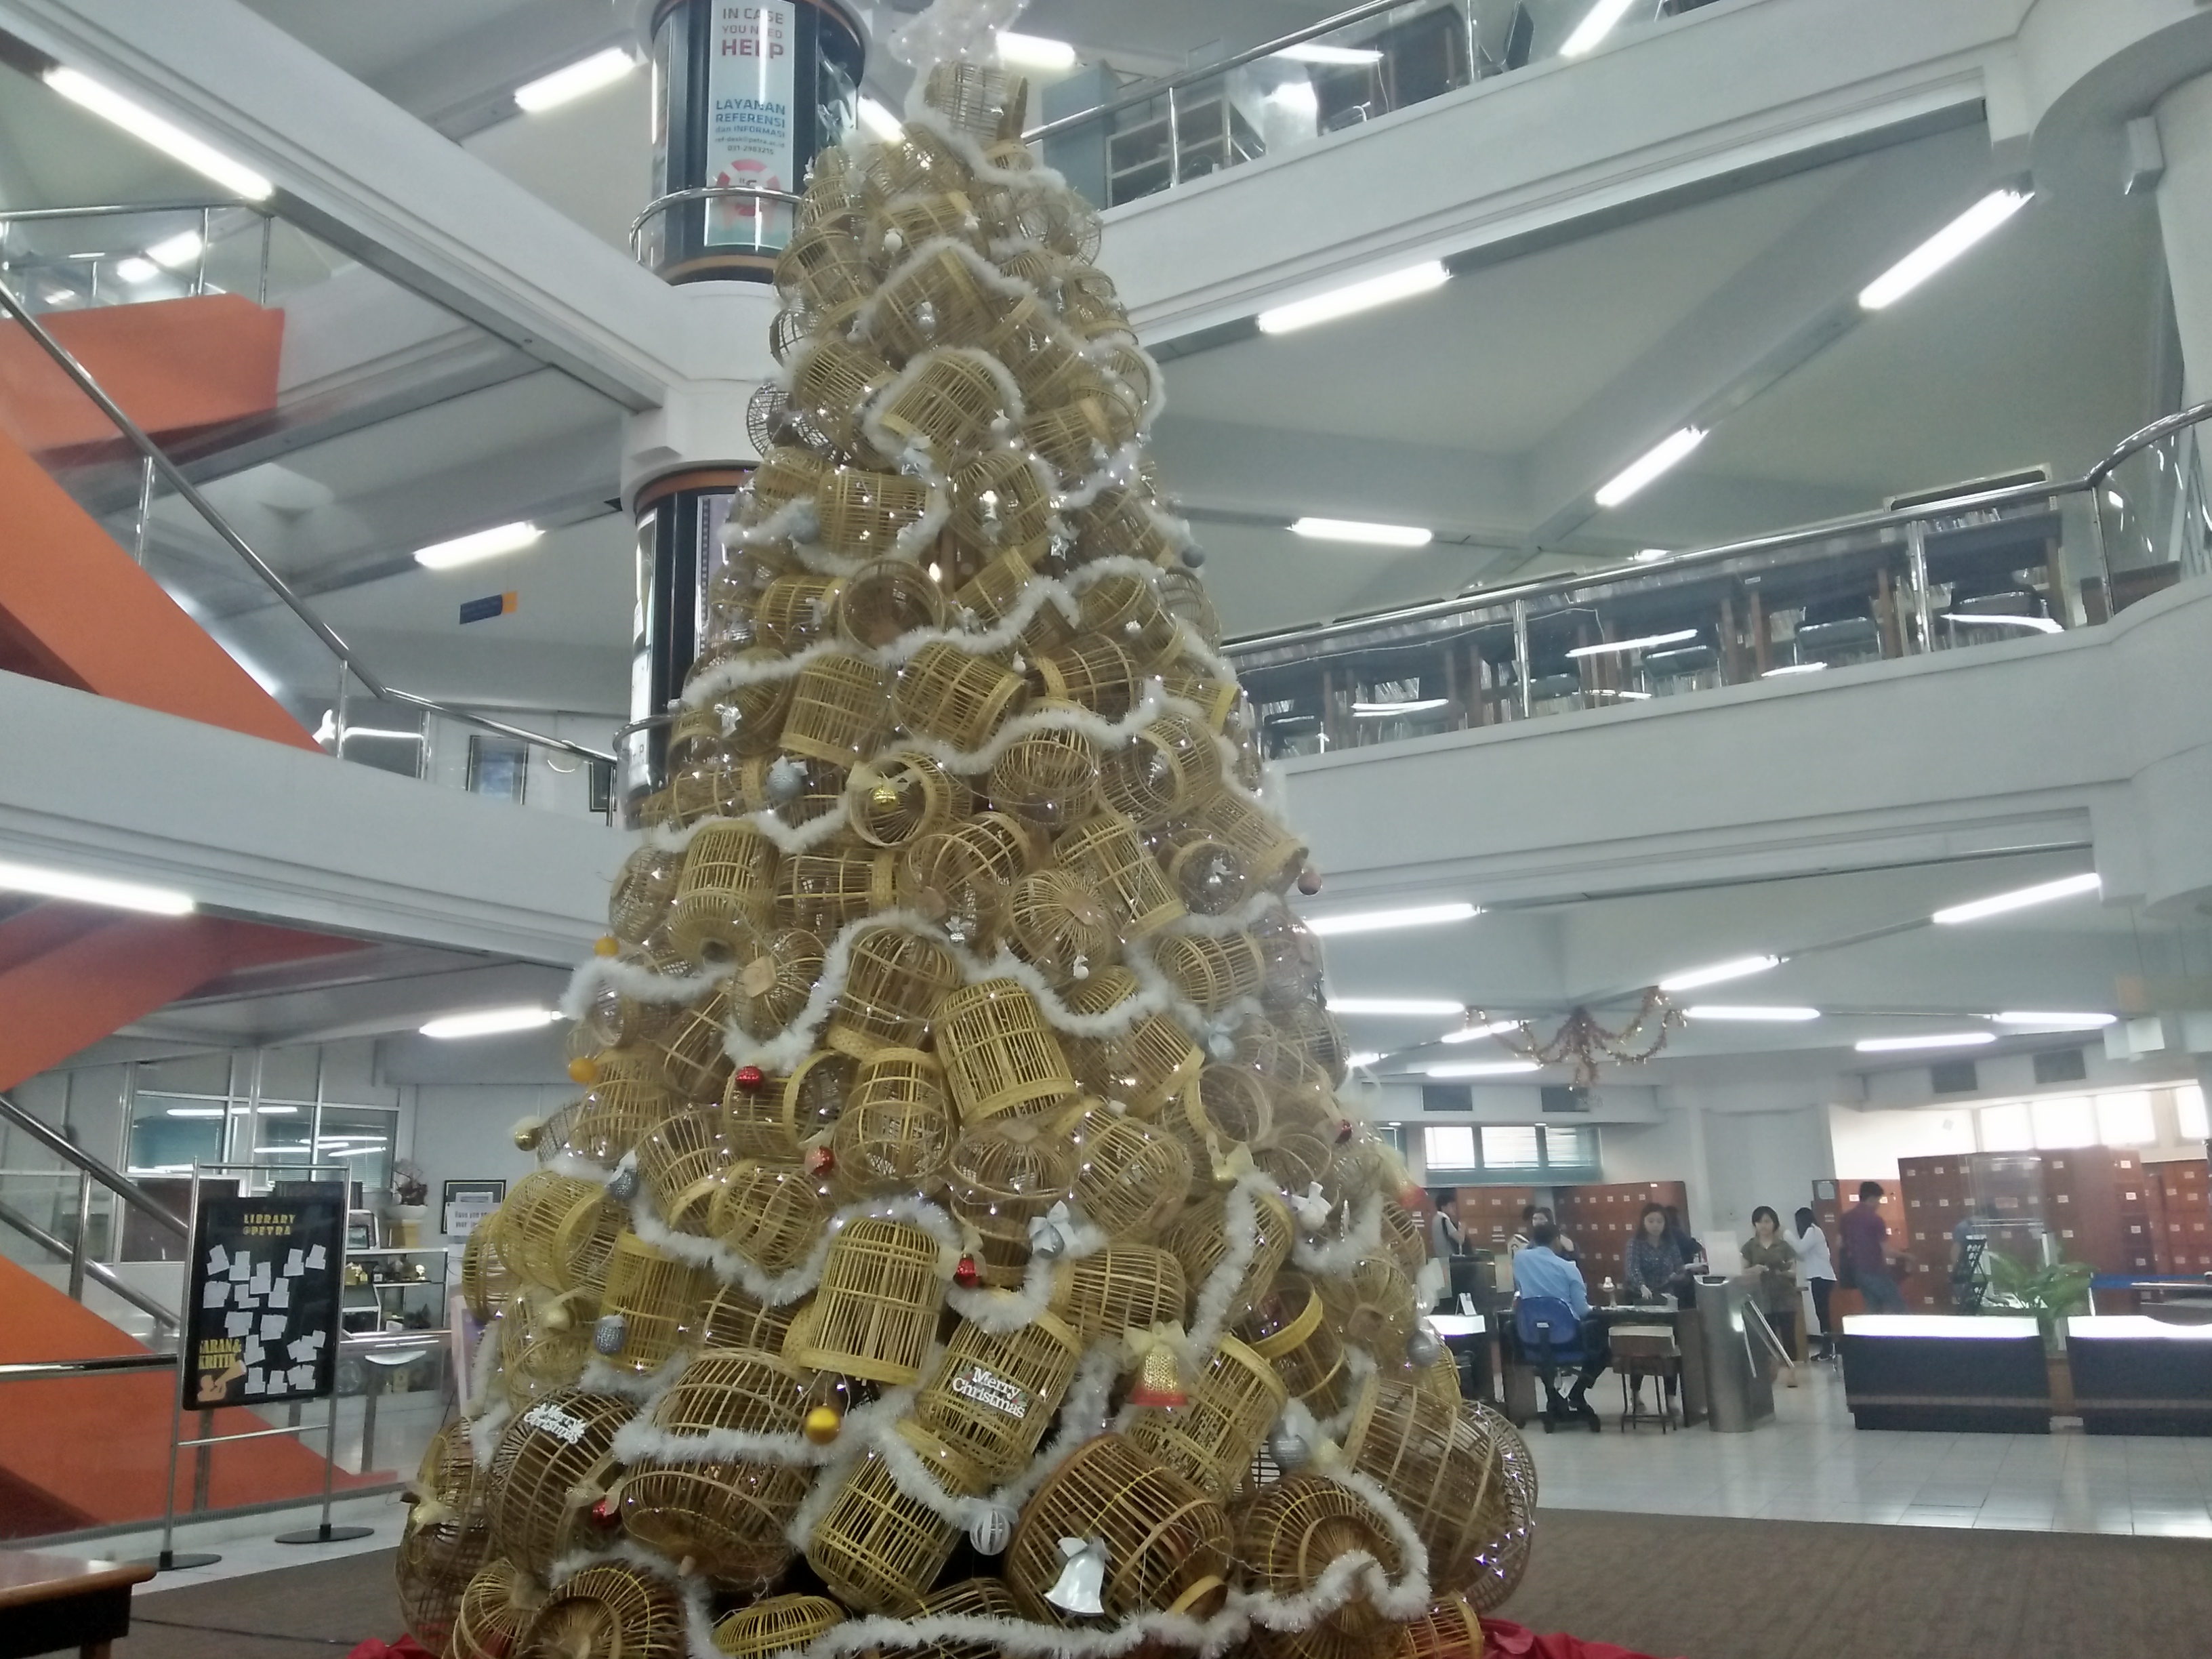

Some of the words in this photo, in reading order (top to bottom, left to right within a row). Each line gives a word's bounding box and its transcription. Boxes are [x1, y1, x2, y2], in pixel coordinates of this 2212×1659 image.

[722, 7, 739, 20] IN
[744, 7, 783, 24] CASE
[722, 24, 746, 33] YOU
[750, 25, 782, 39] NED
[716, 98, 785, 115] LAYANAN
[716, 112, 785, 128] REFERENSI
[734, 125, 785, 138] INFORMASI
[244, 1214, 295, 1224] LIBRARY
[973, 1366, 1022, 1400] Merry
[952, 1376, 1025, 1418] Christmas
